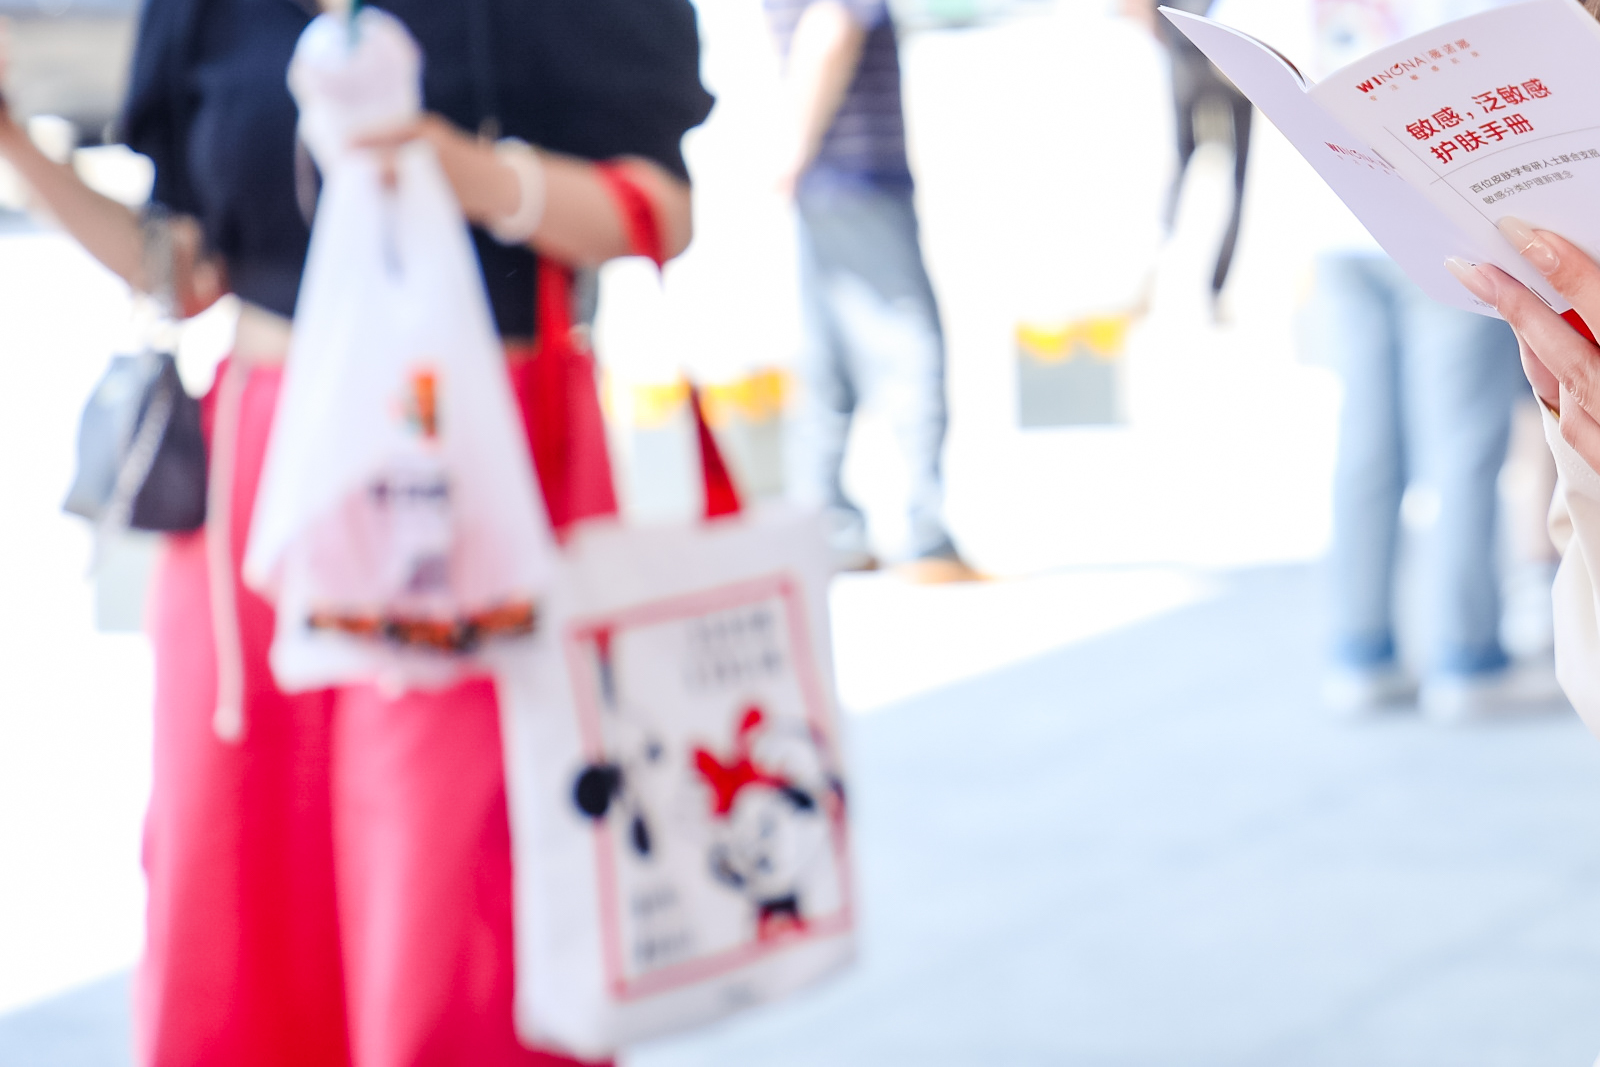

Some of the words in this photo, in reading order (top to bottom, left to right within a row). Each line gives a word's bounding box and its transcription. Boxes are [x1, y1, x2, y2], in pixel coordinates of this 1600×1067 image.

[1355, 56, 1427, 93] WINONA
[1430, 113, 1534, 164] 护肤手册
